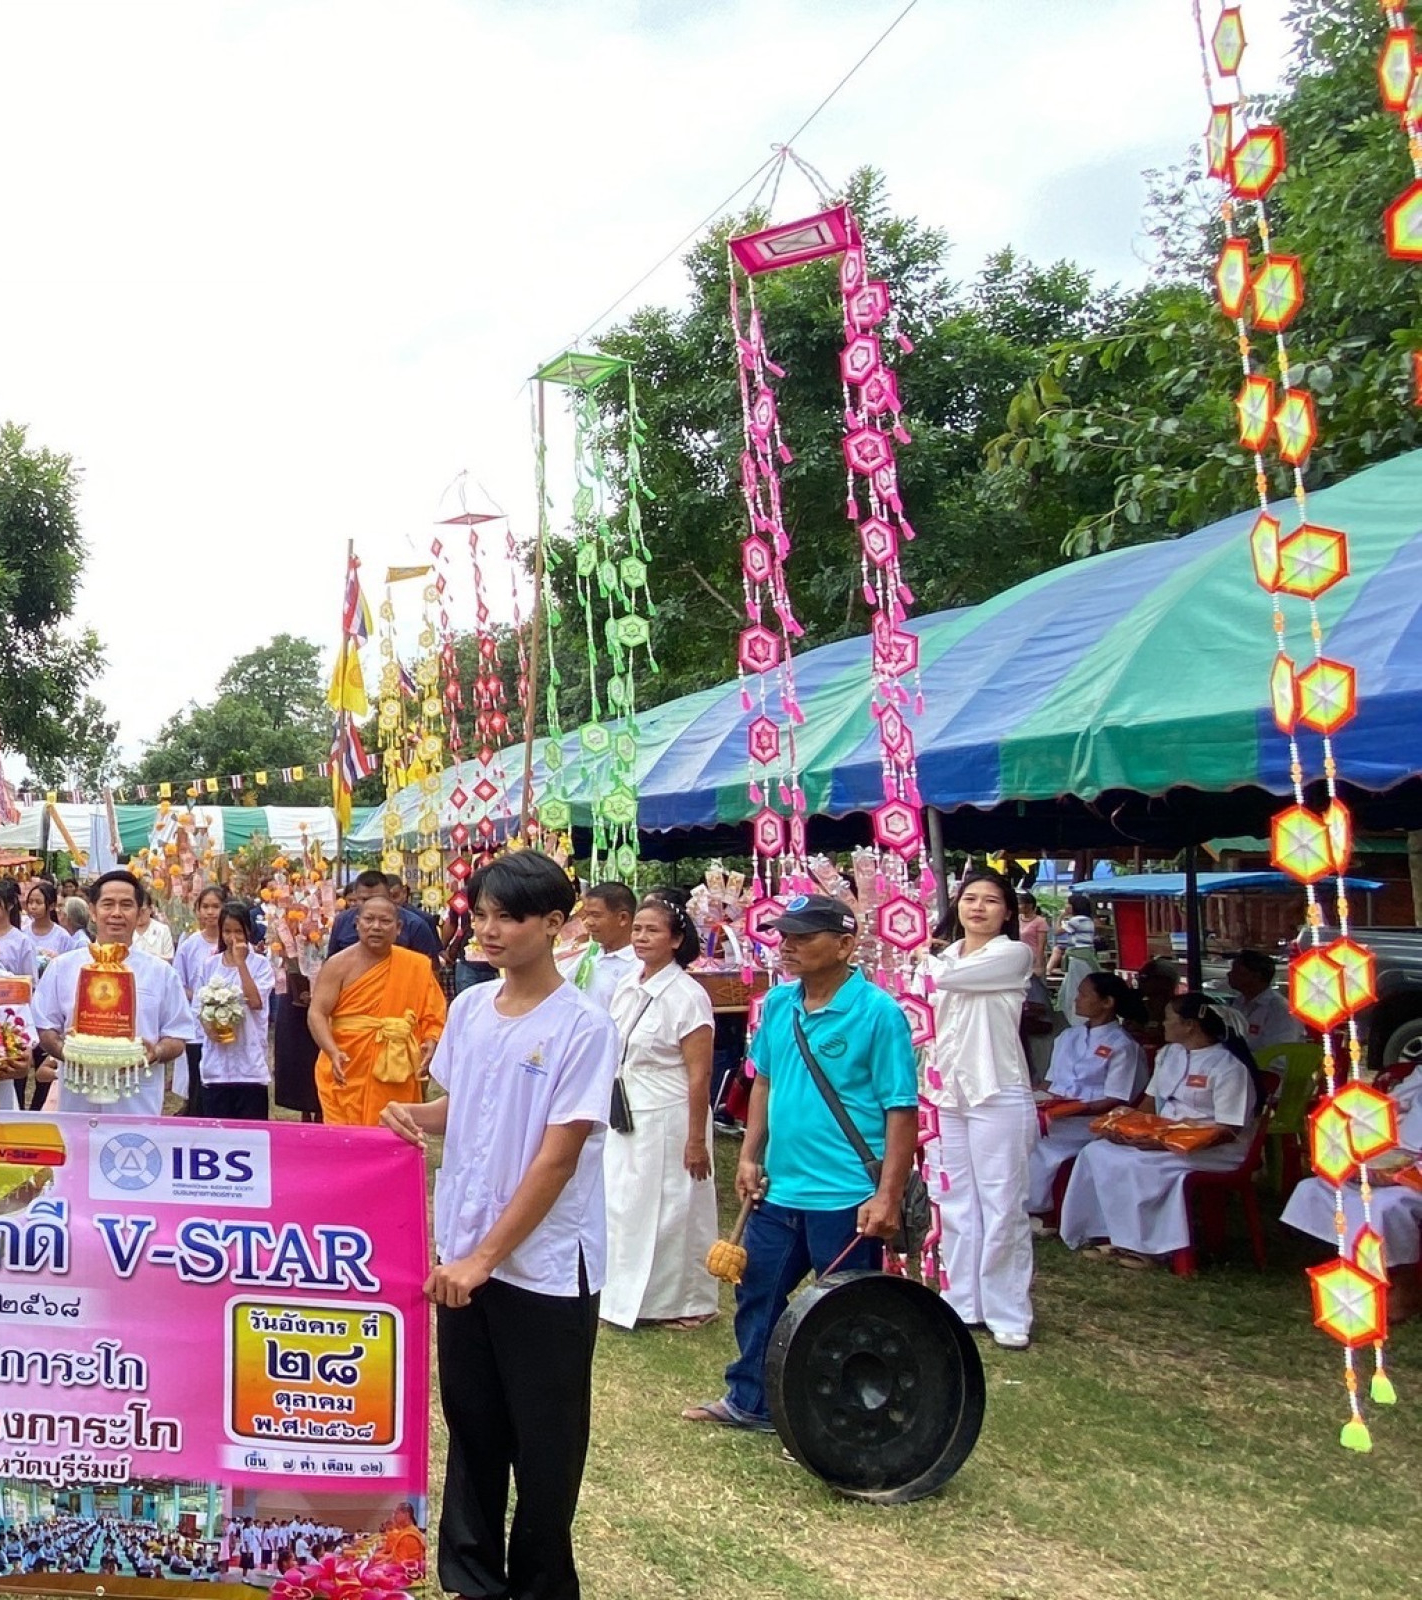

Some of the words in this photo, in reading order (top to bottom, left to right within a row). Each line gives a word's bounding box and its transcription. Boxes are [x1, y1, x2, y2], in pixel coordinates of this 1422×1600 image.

[172, 1147, 253, 1182] IBS
[96, 1217, 377, 1288] V-STAR
[249, 1310, 348, 1336] วันอังคาร
[361, 1315, 380, 1338] ที่
[266, 1338, 365, 1386] ๒๘
[275, 1391, 354, 1413] ตุลาคม
